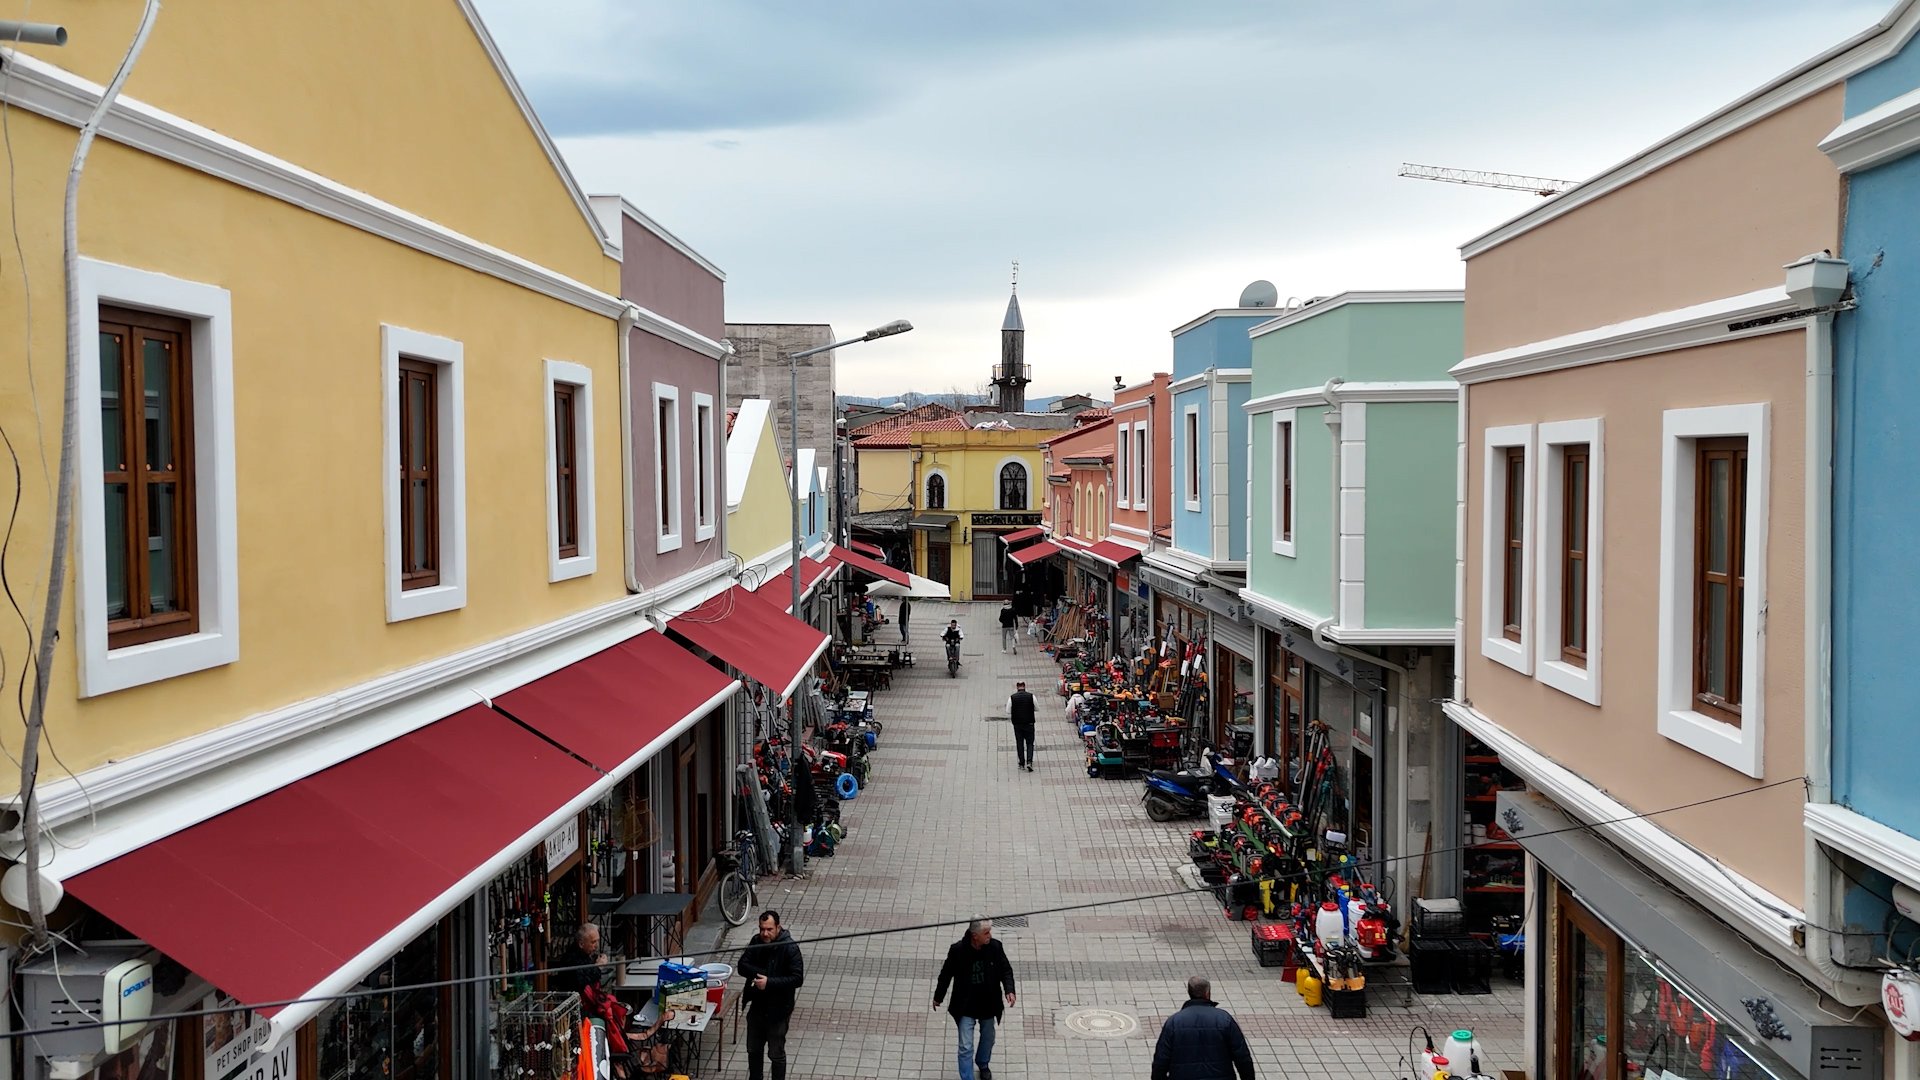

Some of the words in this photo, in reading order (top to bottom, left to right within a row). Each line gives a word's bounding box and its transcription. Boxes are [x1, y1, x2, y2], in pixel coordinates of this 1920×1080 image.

[216, 1050, 231, 1072] PET
[233, 1036, 251, 1060] SHOP
[253, 1021, 272, 1044] ÜRÜN
